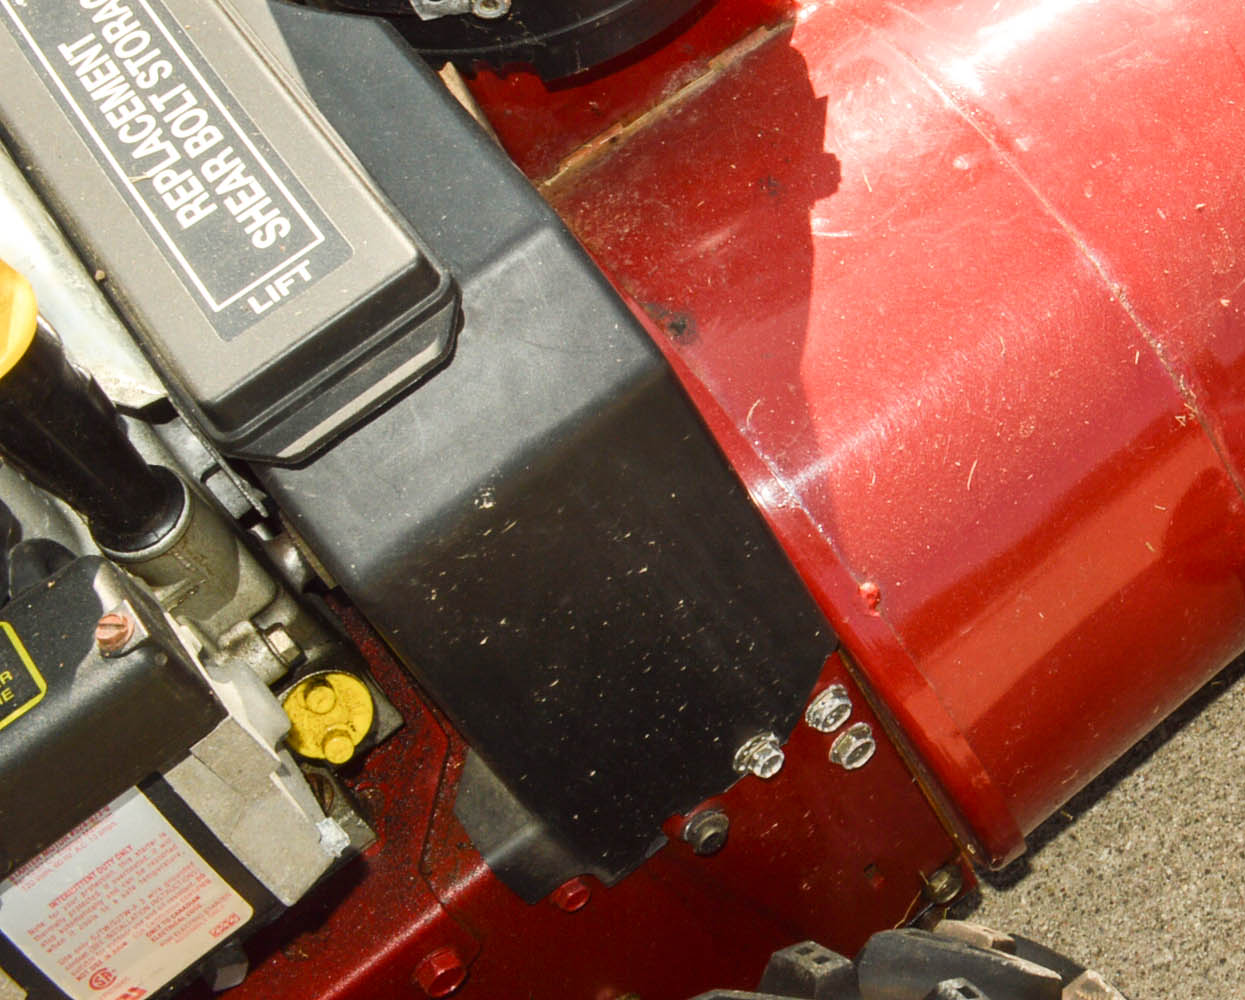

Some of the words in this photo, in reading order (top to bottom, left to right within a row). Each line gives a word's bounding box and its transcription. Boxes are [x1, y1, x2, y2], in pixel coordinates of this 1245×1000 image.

[58, 34, 218, 230] REPLACEMENT
[149, 84, 225, 159] BOLT
[200, 148, 291, 249] SHEAR
[247, 259, 314, 314] LIFT
[0, 671, 13, 687] R
